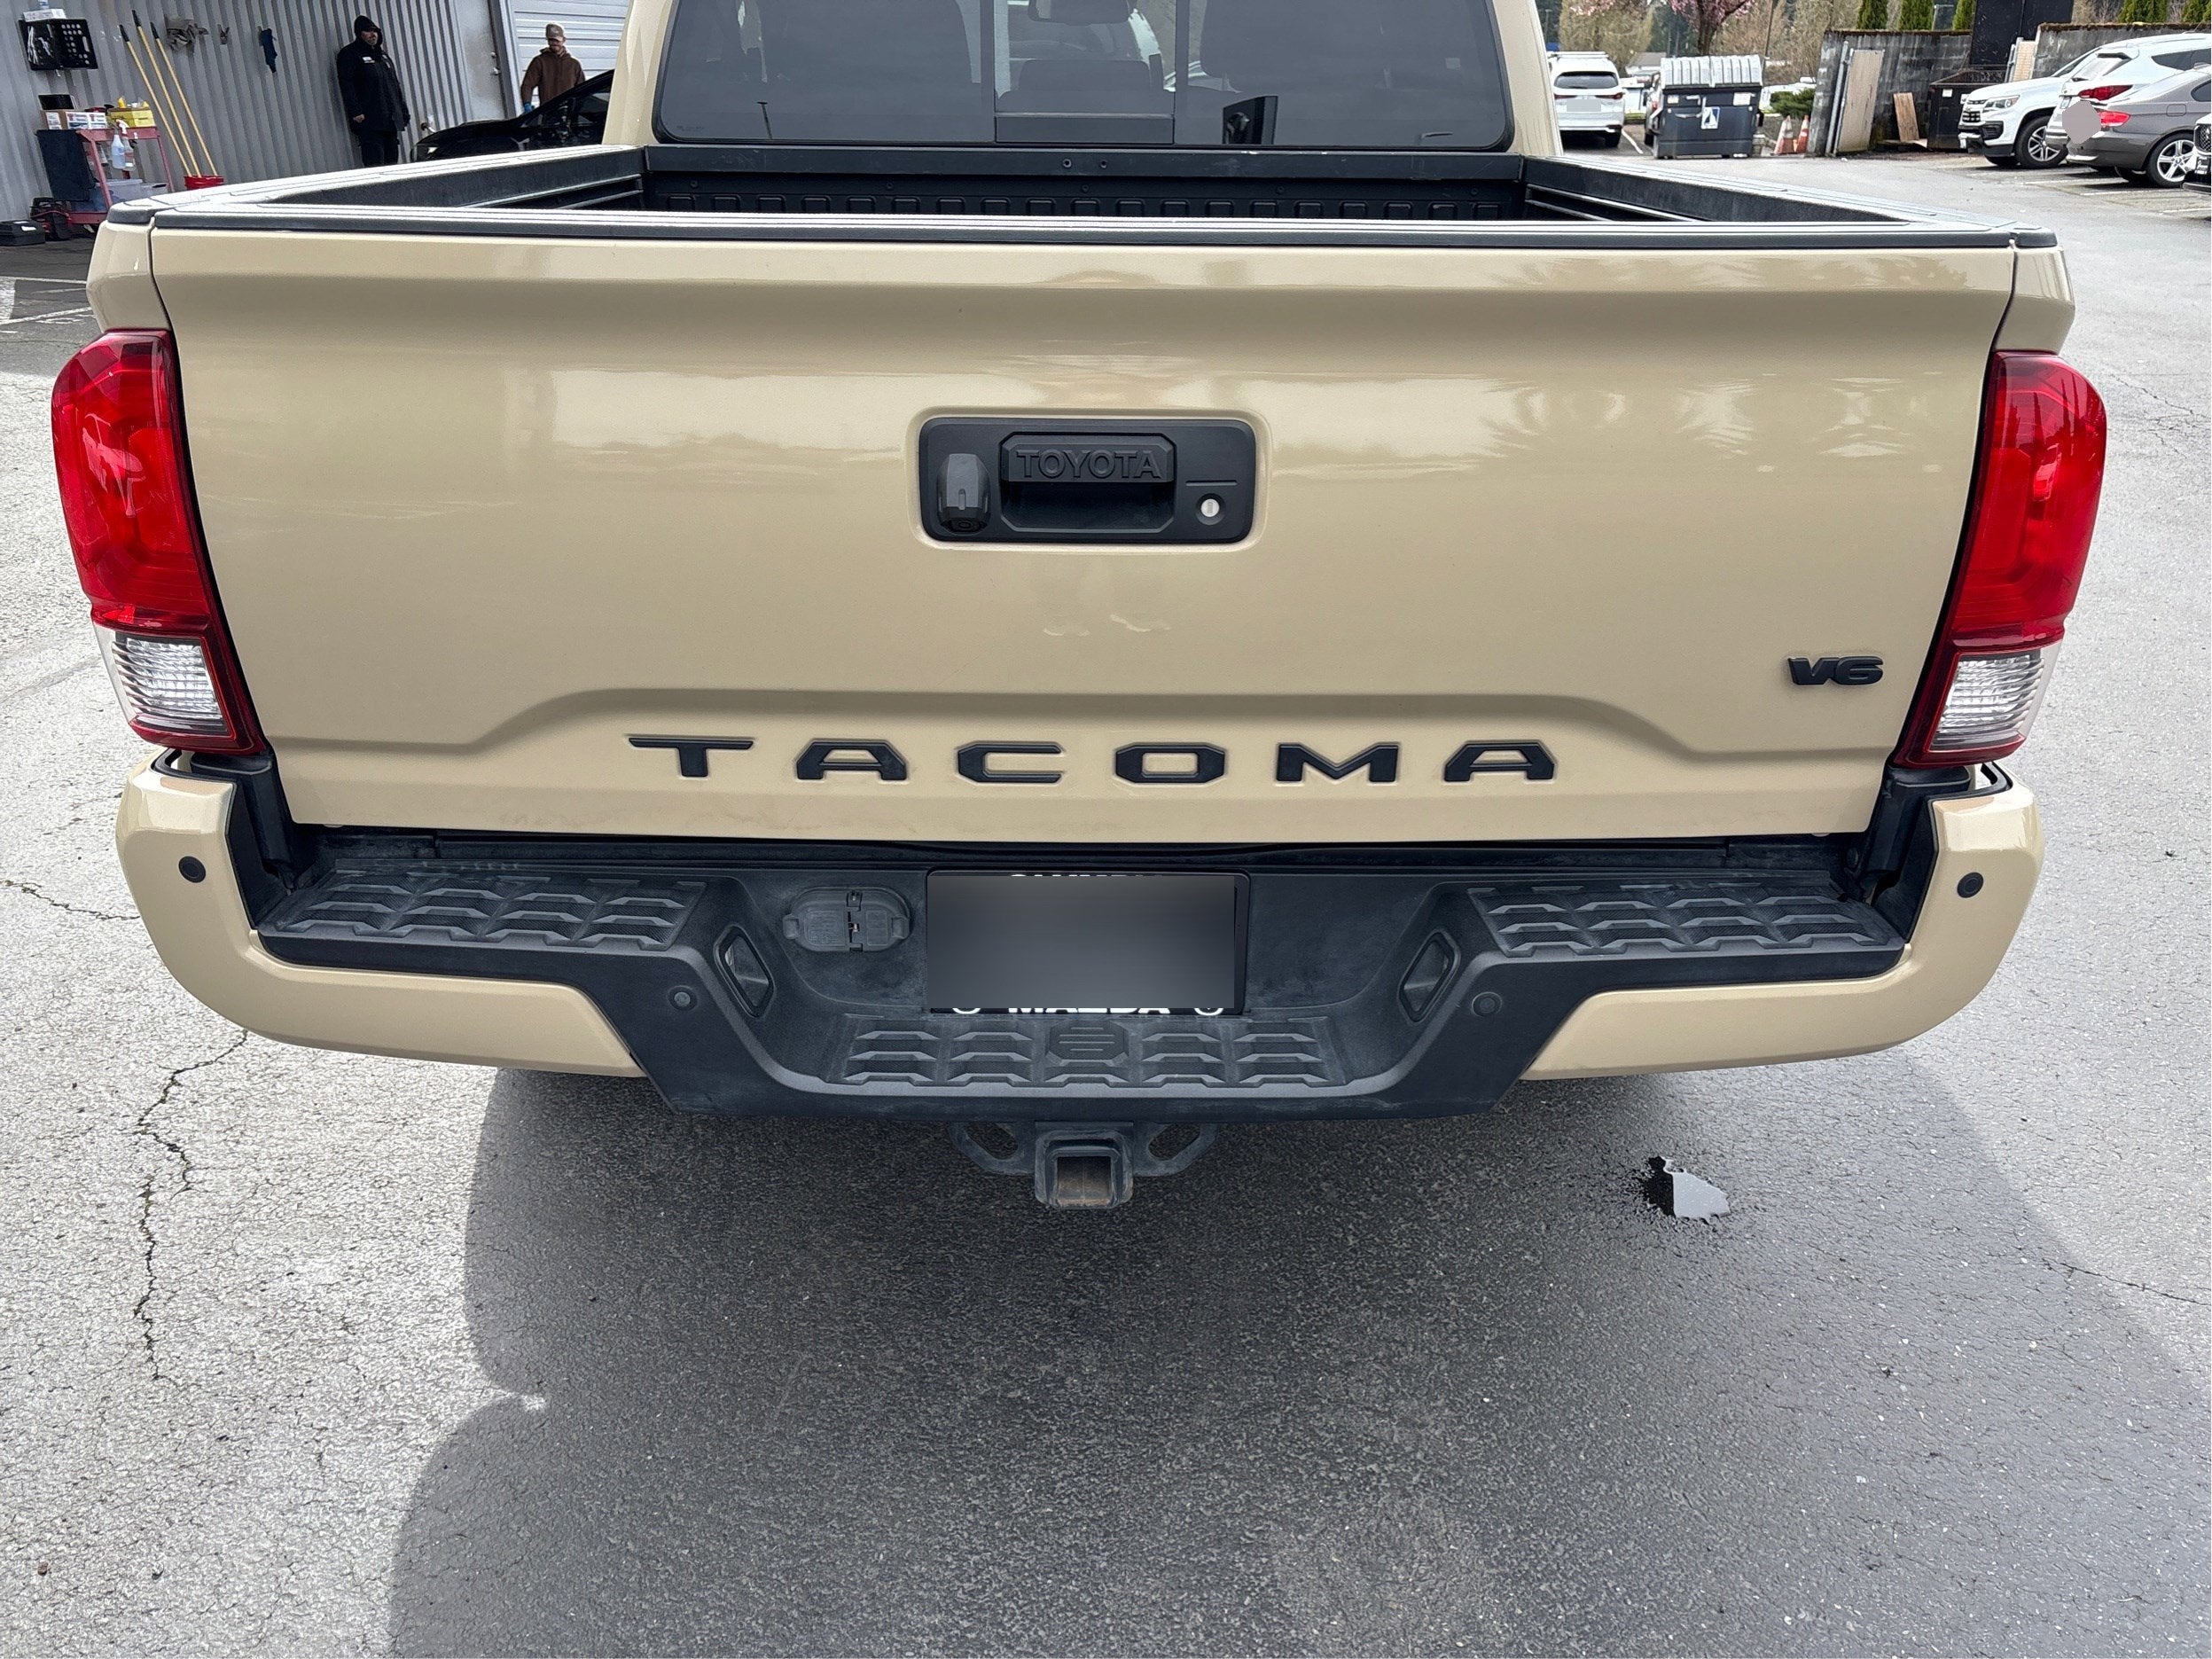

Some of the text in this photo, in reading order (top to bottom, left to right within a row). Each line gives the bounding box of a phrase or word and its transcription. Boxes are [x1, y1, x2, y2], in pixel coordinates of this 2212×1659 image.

[1017, 450, 1161, 479] TOYOTA
[1787, 655, 1884, 685] V6
[629, 736, 1555, 784] TACOMA
